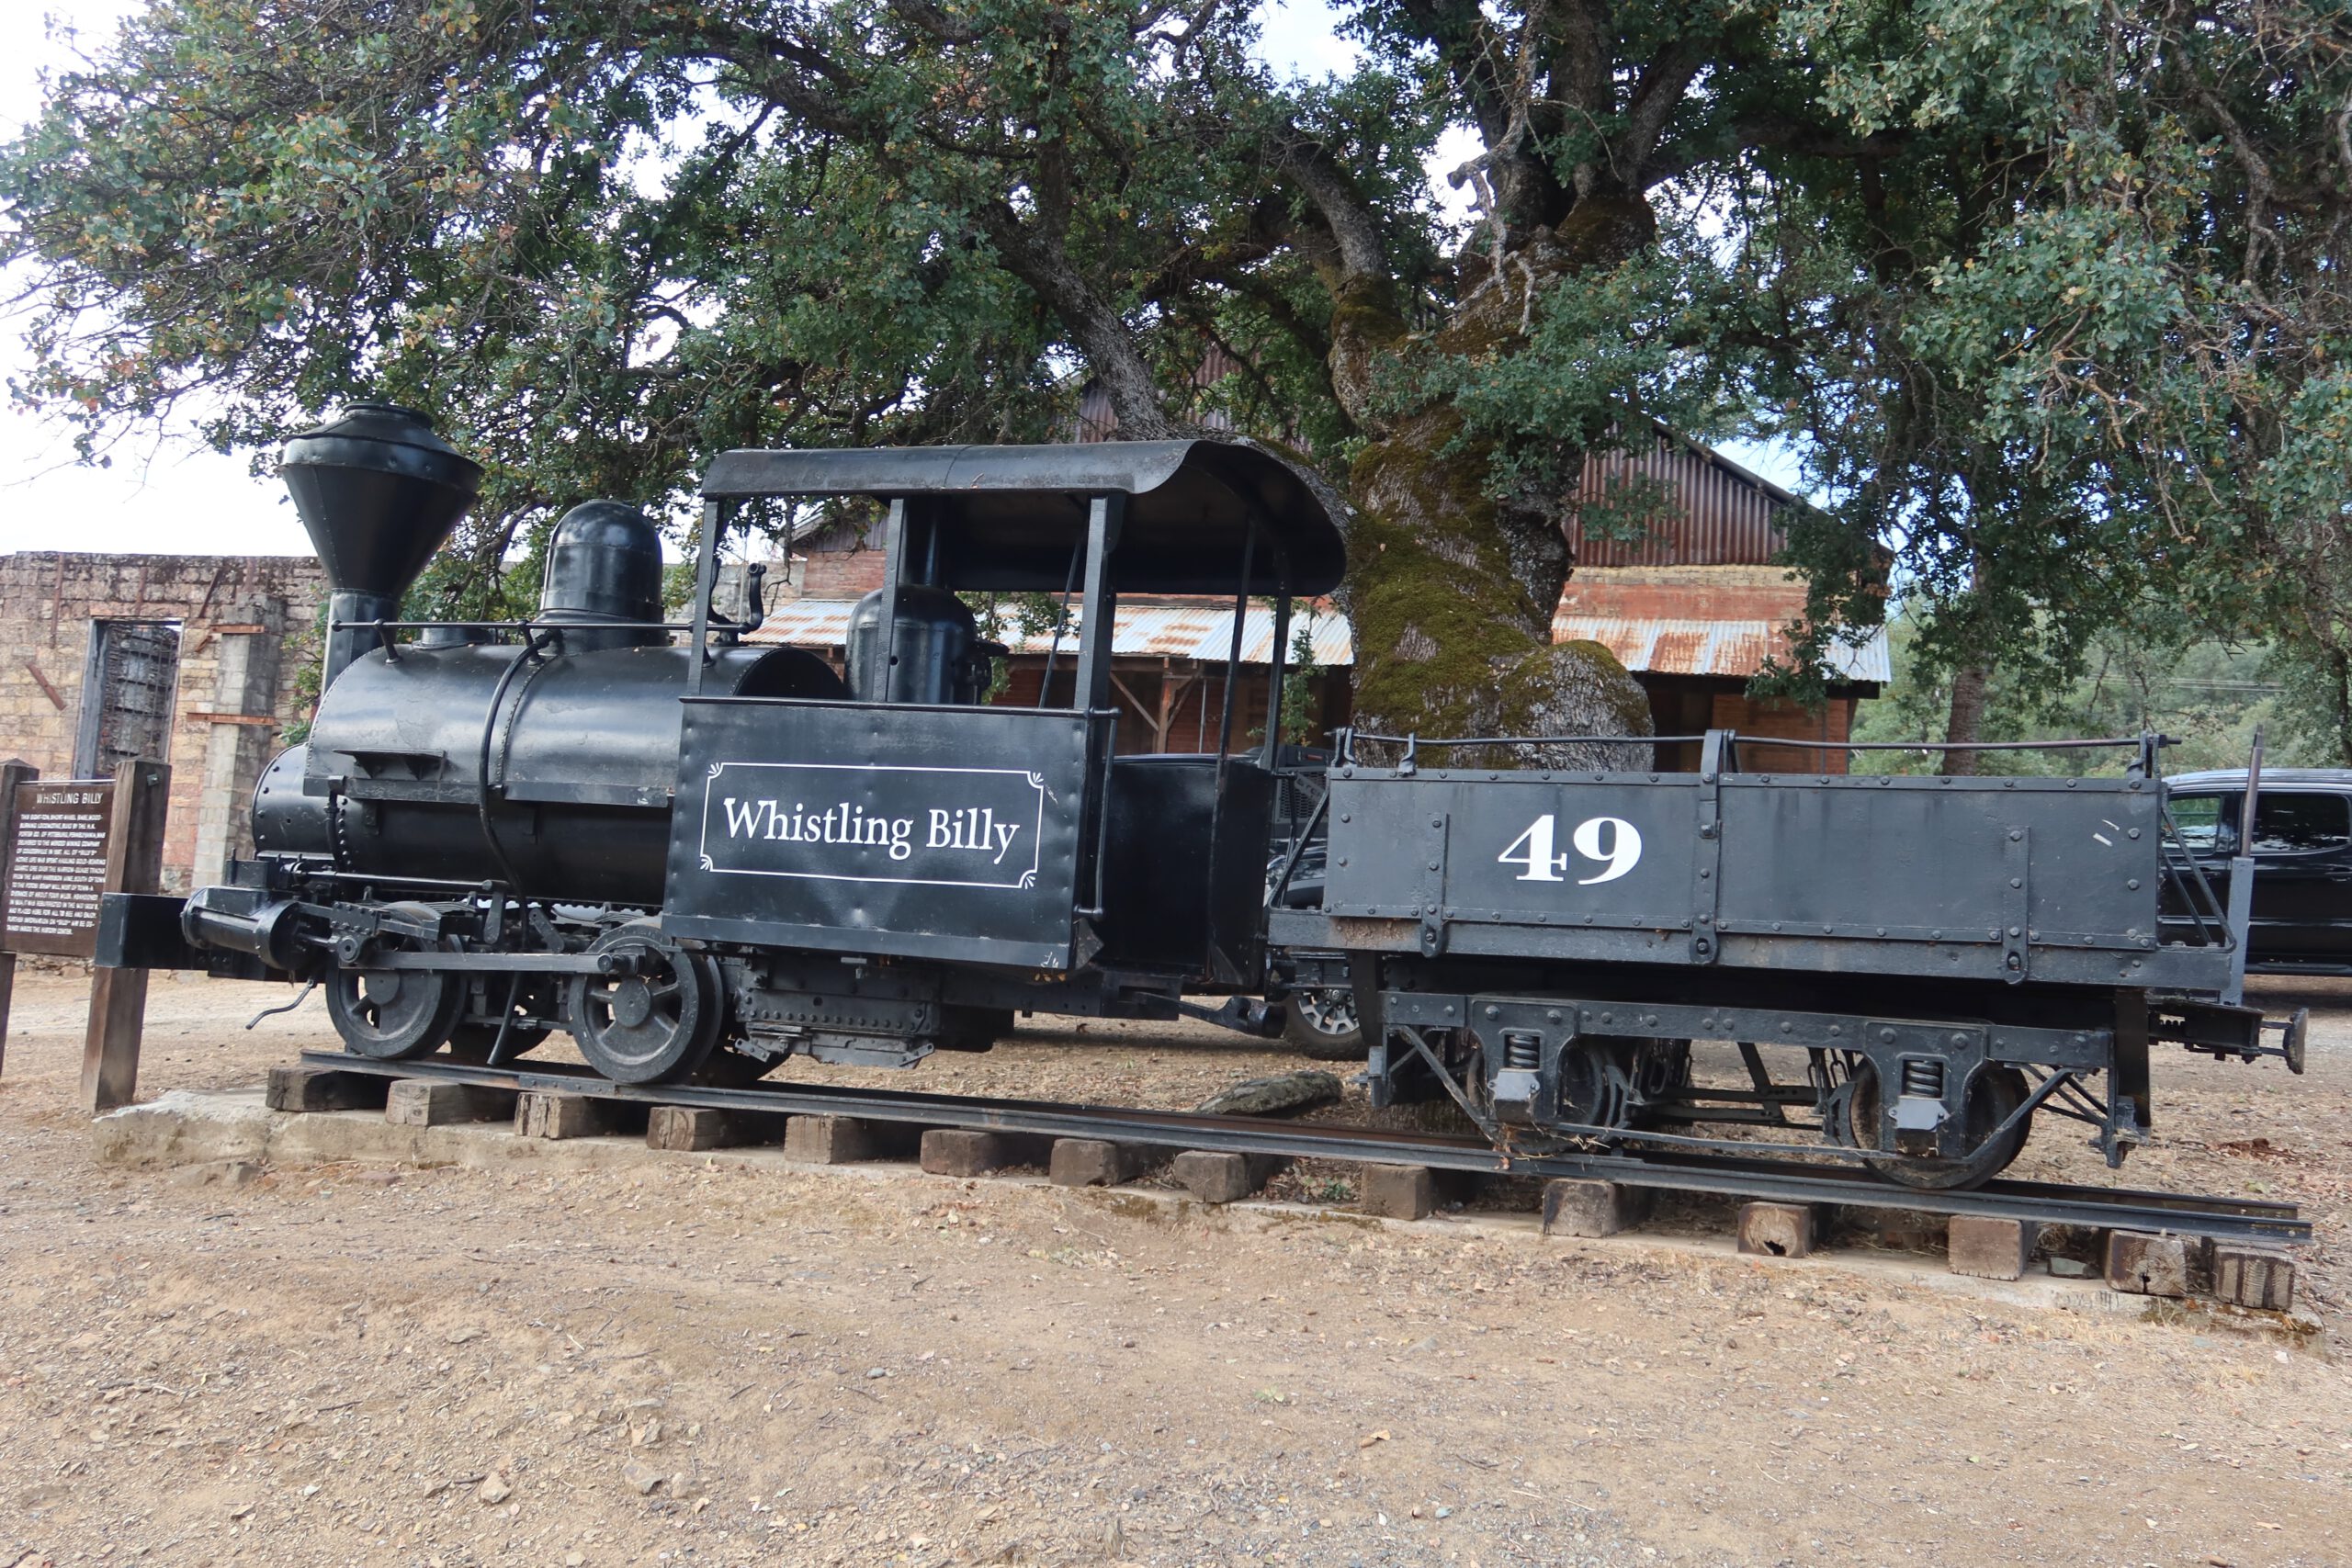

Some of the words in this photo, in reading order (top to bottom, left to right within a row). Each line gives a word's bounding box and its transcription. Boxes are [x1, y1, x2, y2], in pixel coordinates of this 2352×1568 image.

[36, 792, 79, 804] WHISTLING
[82, 792, 103, 804] BILLY
[724, 798, 913, 860] Whistling
[926, 808, 1020, 864] Billy
[1498, 815, 1642, 885] 49
